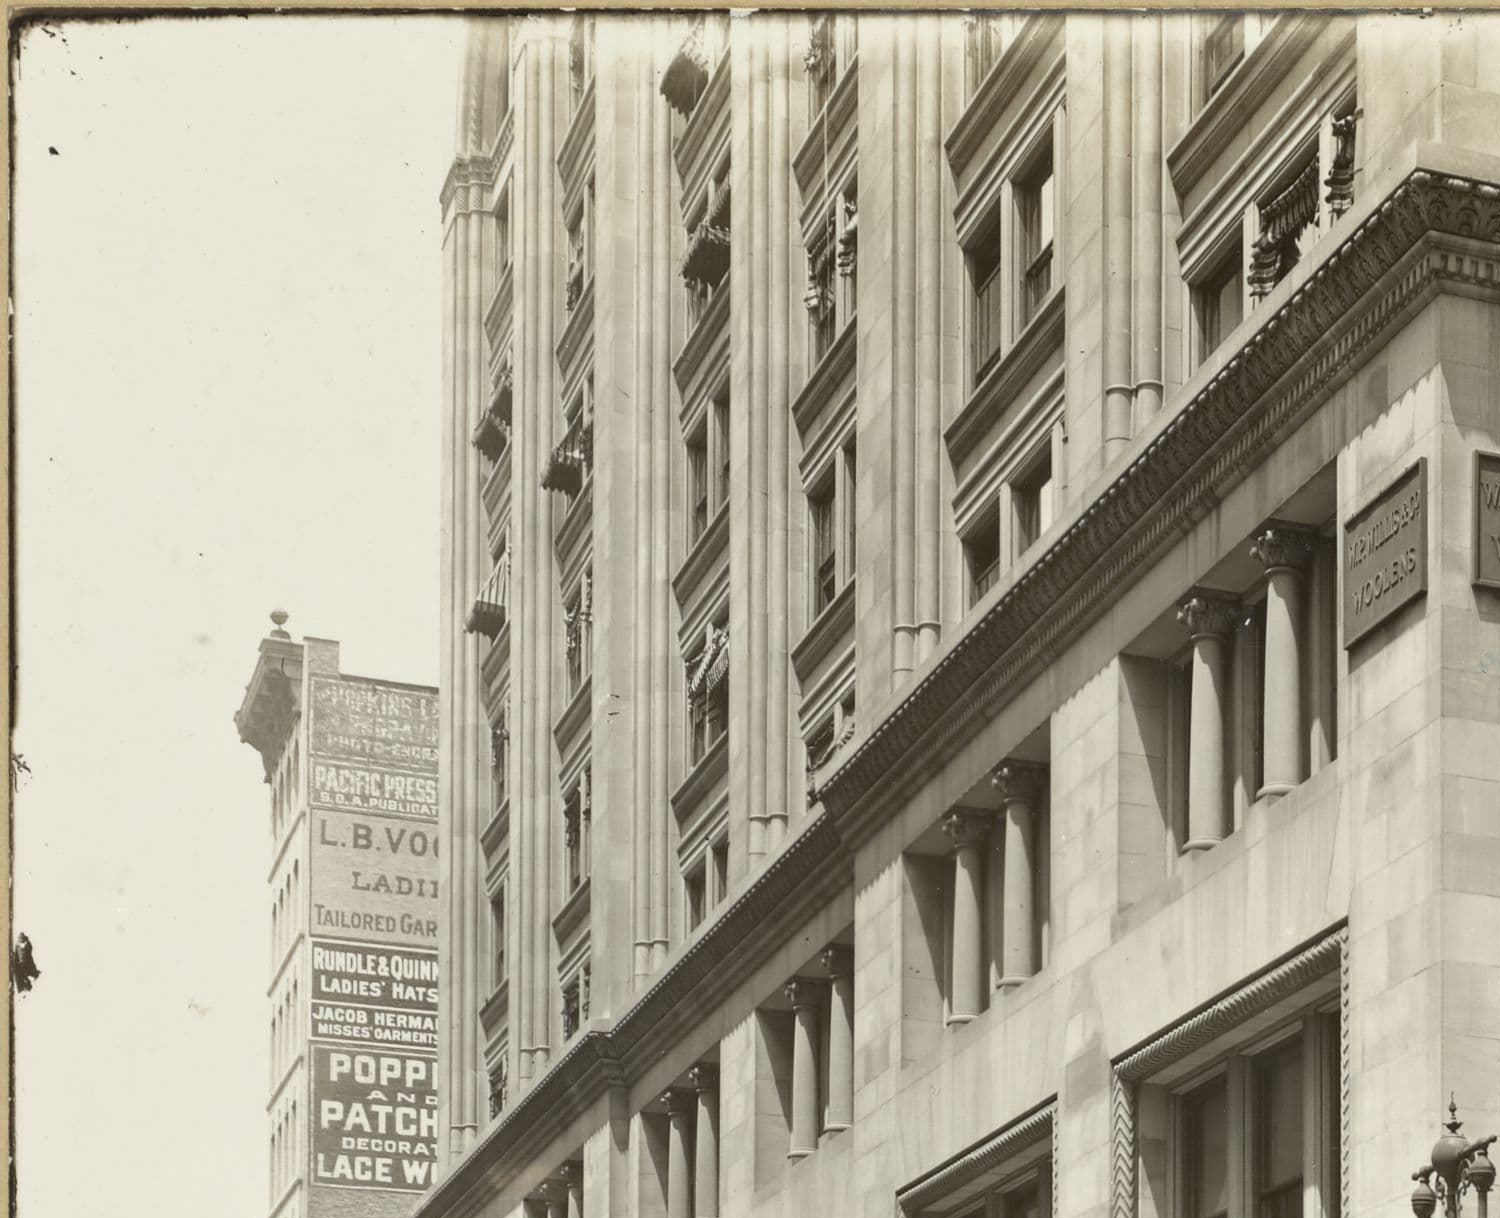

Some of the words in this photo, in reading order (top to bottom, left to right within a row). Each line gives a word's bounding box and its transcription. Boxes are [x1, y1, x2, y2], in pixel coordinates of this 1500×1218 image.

[1401, 503, 1409, 529] &
[1352, 545, 1416, 616] WOOLENS
[315, 765, 380, 797] PACIFIC
[384, 773, 437, 803] PRESS
[314, 903, 396, 933] TAILORED
[400, 913, 438, 938] GAR
[320, 974, 386, 997] LADIES'
[391, 982, 438, 1003] HATS
[312, 1006, 368, 1024] JACOB
[373, 1012, 438, 1030] HERMA
[320, 1100, 438, 1138] PATCH
[316, 1152, 392, 1184] LACE
